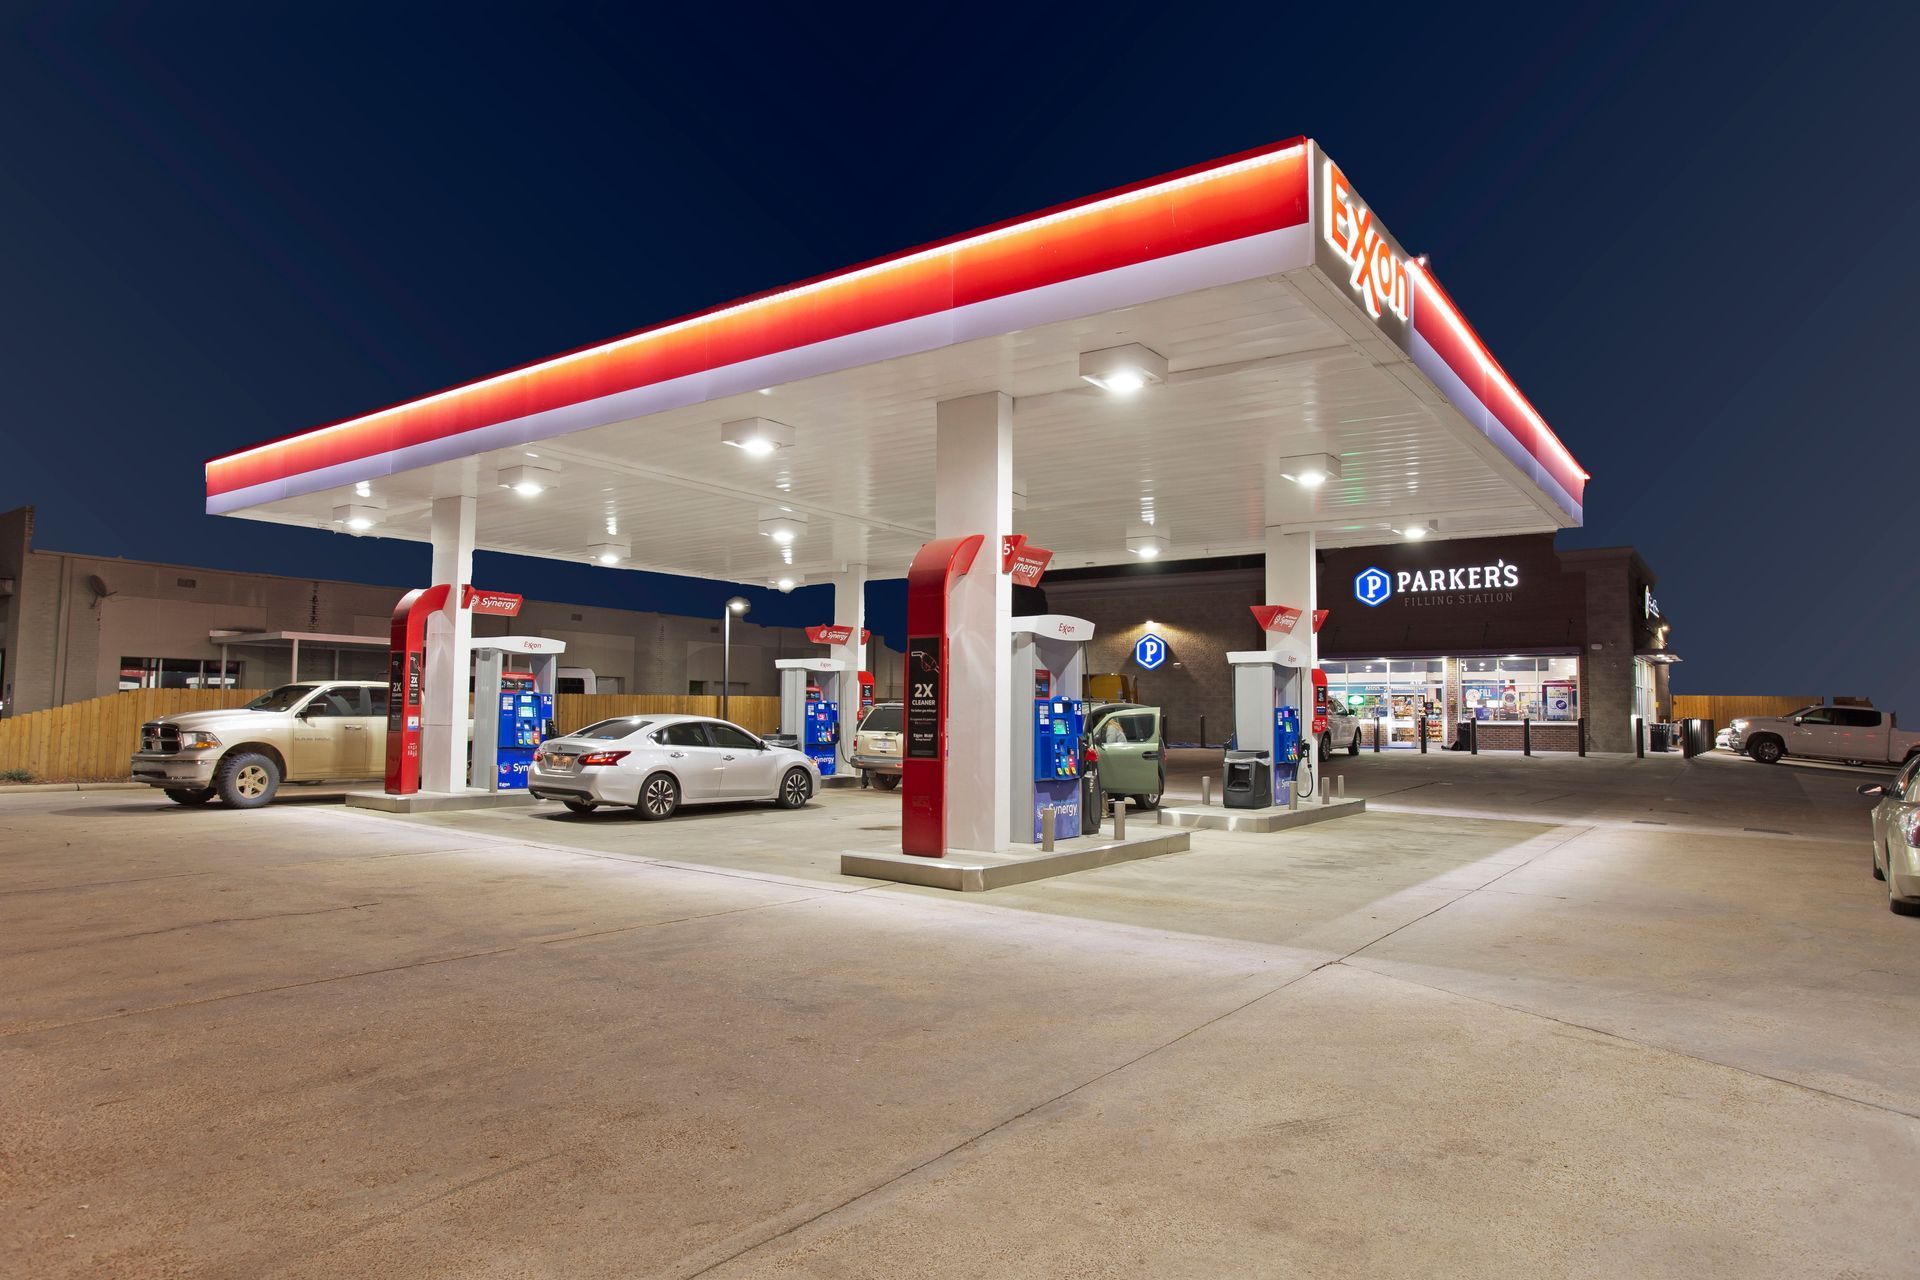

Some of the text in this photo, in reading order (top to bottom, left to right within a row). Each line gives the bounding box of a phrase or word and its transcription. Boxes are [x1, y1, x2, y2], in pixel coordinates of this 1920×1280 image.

[1324, 160, 1409, 321] Exxon
[1010, 562, 1041, 577] ynergy
[1397, 558, 1519, 593] PARKER'S
[481, 597, 516, 610] Synergy
[1404, 592, 1513, 607] FILLING STATION
[1059, 622, 1075, 635] Exxon
[827, 631, 848, 641] Synergy
[523, 640, 542, 649] Exxon
[1145, 641, 1157, 662] P
[393, 682, 402, 692] 2X
[914, 683, 934, 698] 2X
[513, 763, 529, 774] Syn
